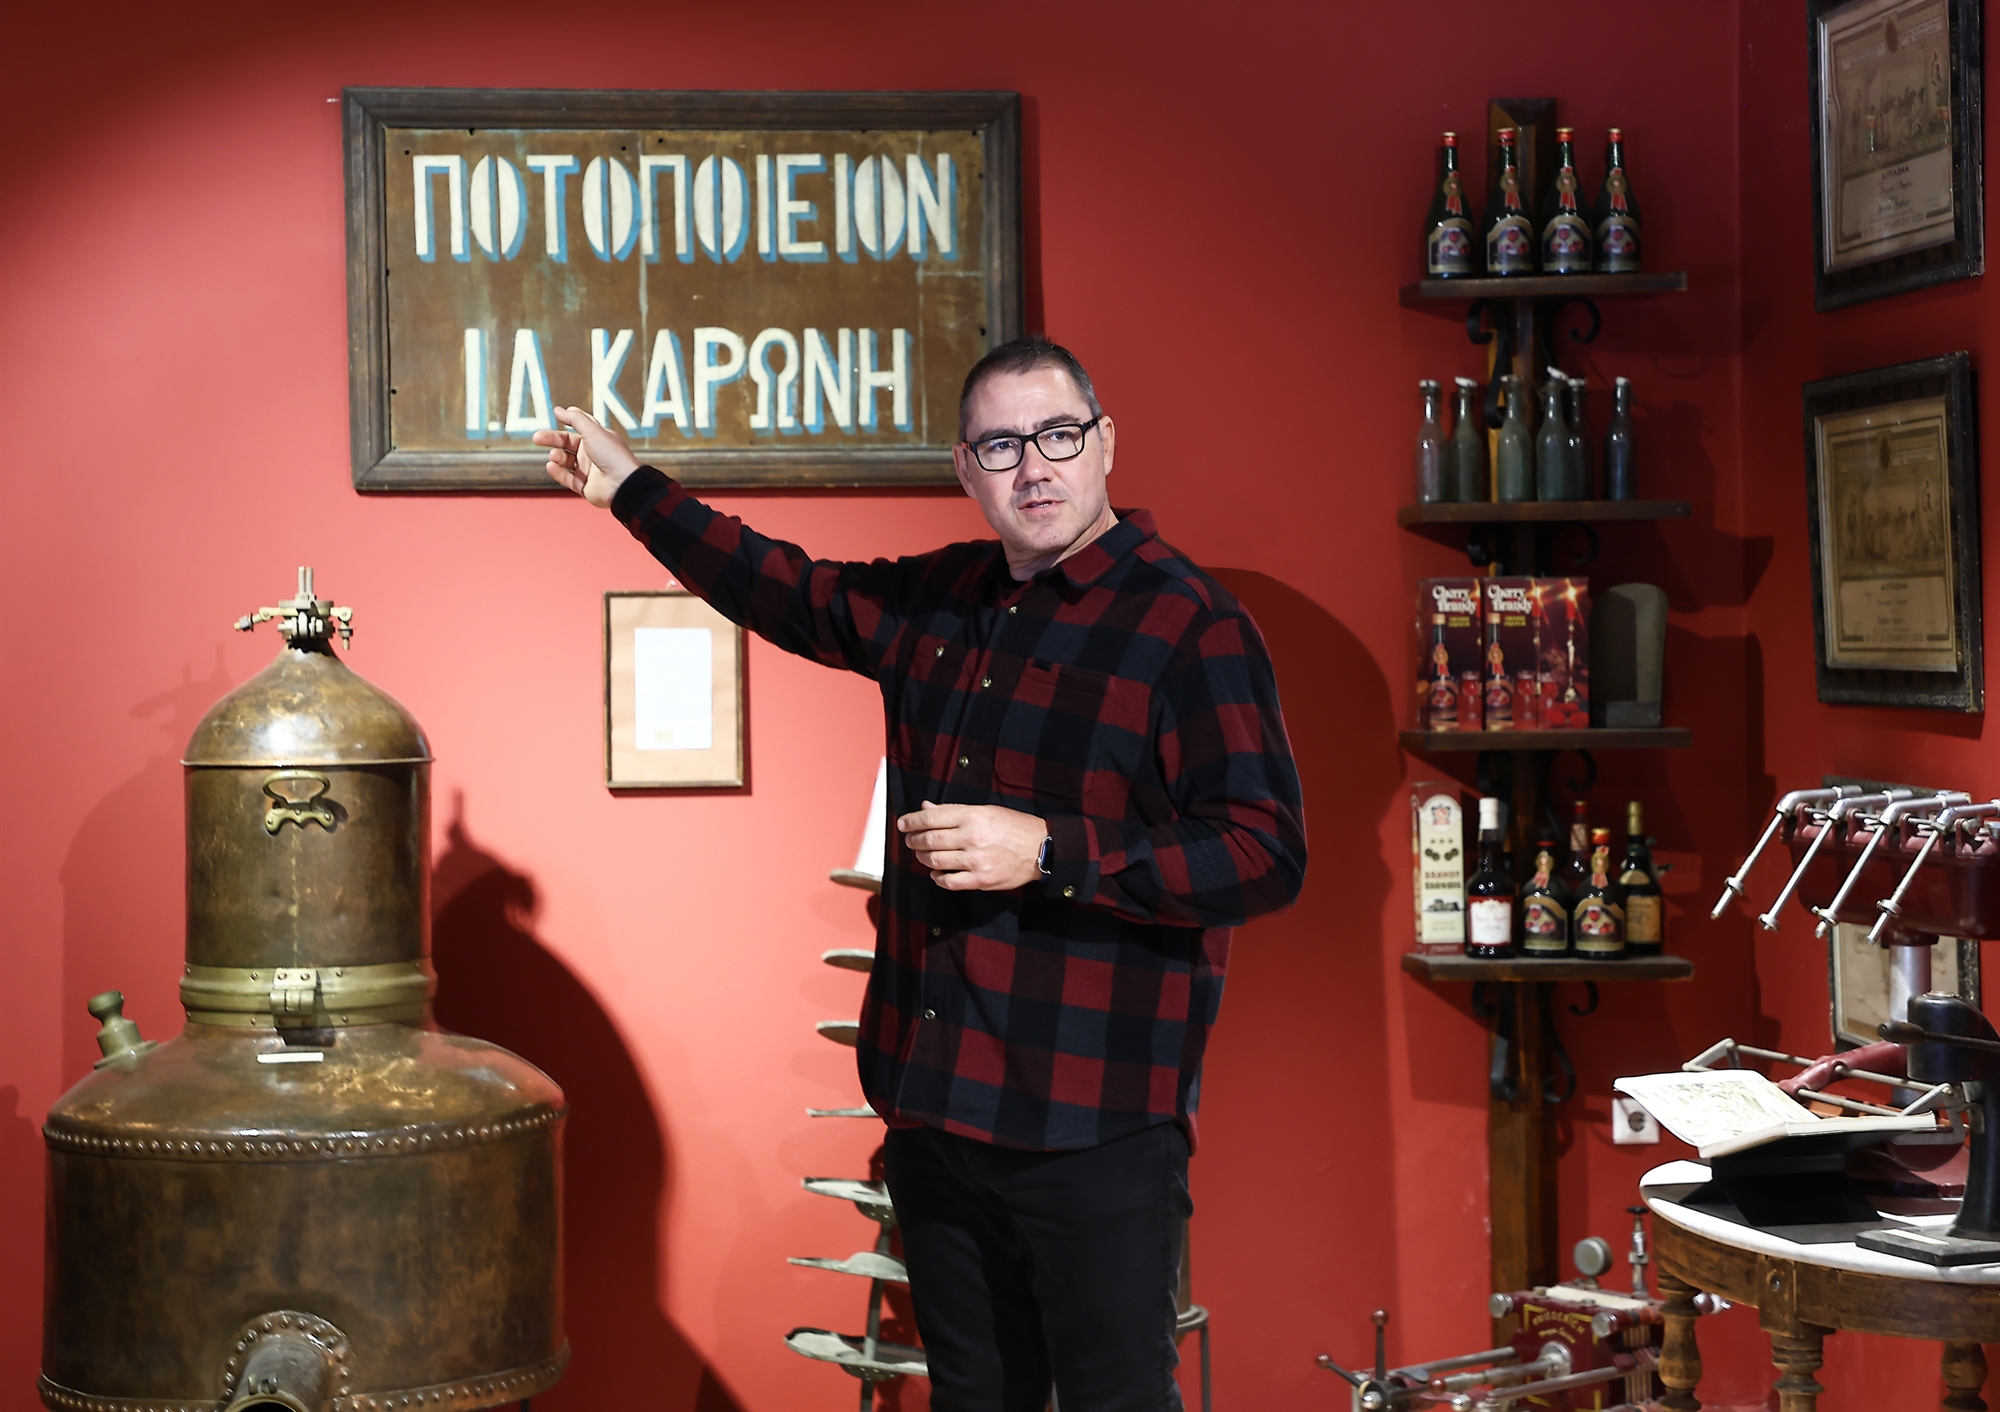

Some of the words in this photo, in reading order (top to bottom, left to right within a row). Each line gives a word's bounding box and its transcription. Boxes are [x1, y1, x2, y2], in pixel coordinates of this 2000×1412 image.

[412, 153, 957, 263] ΠΟΤΟΠΟΙΕΙΟΝ
[591, 326, 913, 438] ΚΑΡΩΝΗ
[1432, 585, 1470, 603] Cherry
[1487, 585, 1526, 603] Cherry
[1437, 598, 1476, 615] Brandy
[1492, 598, 1532, 614] Brandy
[1425, 871, 1460, 879] BRANDY
